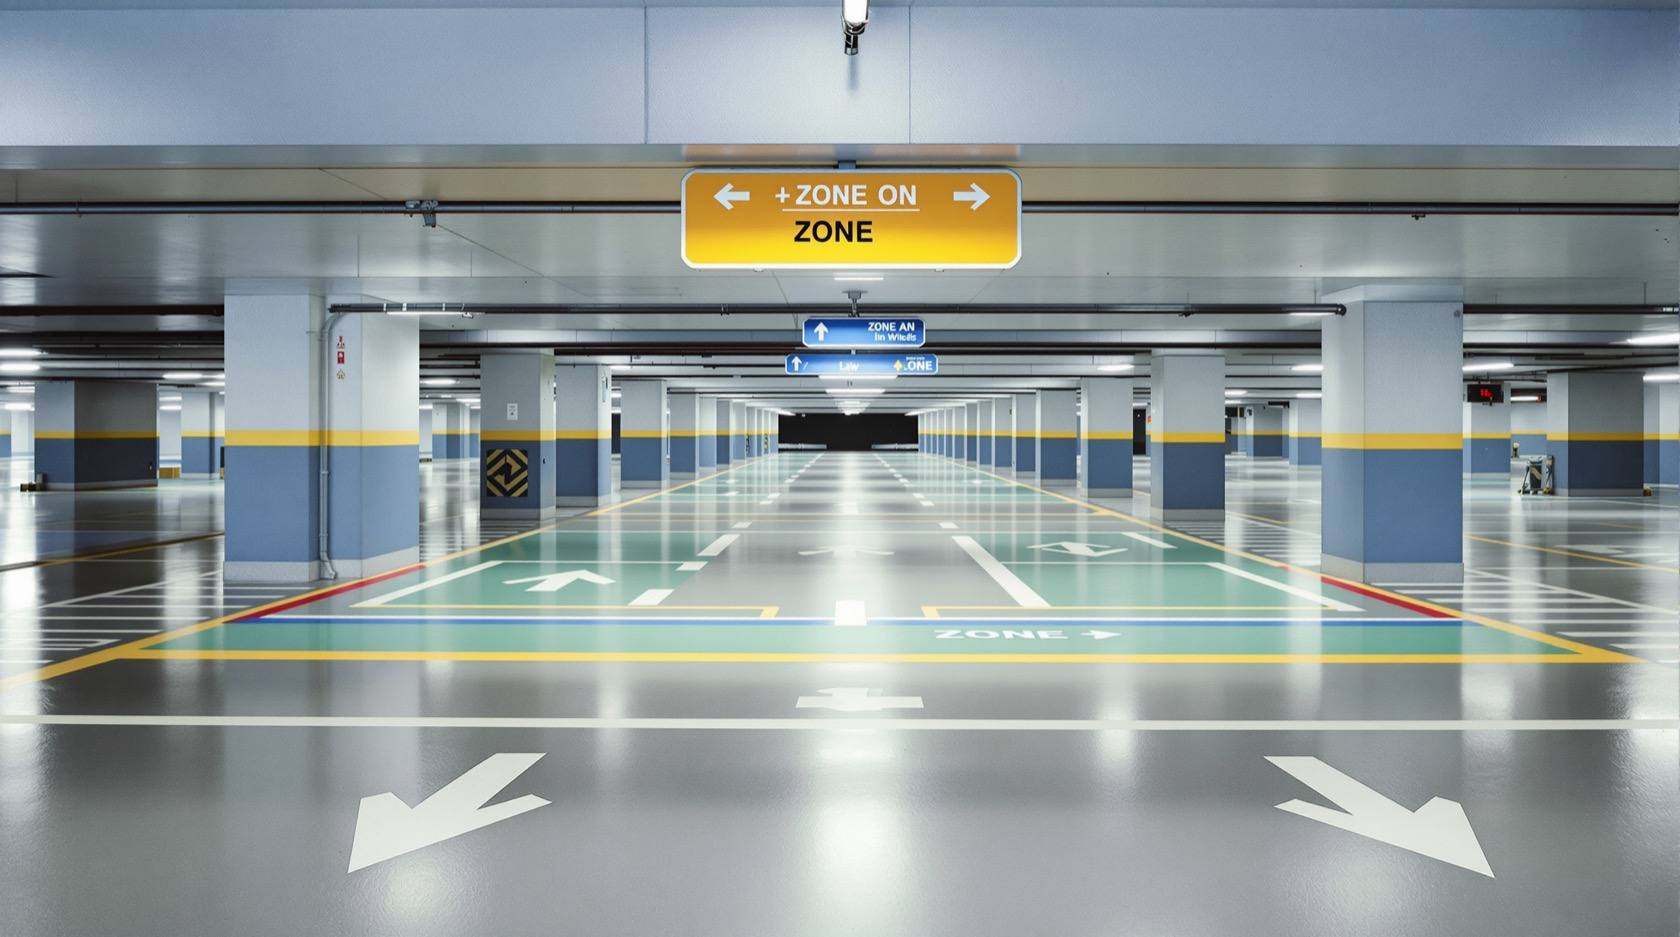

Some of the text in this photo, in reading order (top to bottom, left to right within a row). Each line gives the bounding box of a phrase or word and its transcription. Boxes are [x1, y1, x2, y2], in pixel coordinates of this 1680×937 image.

[878, 184, 917, 206] ON
[794, 220, 873, 243] ZONE
[867, 321, 915, 332] ZONE AN
[934, 629, 1069, 640] ZONE
